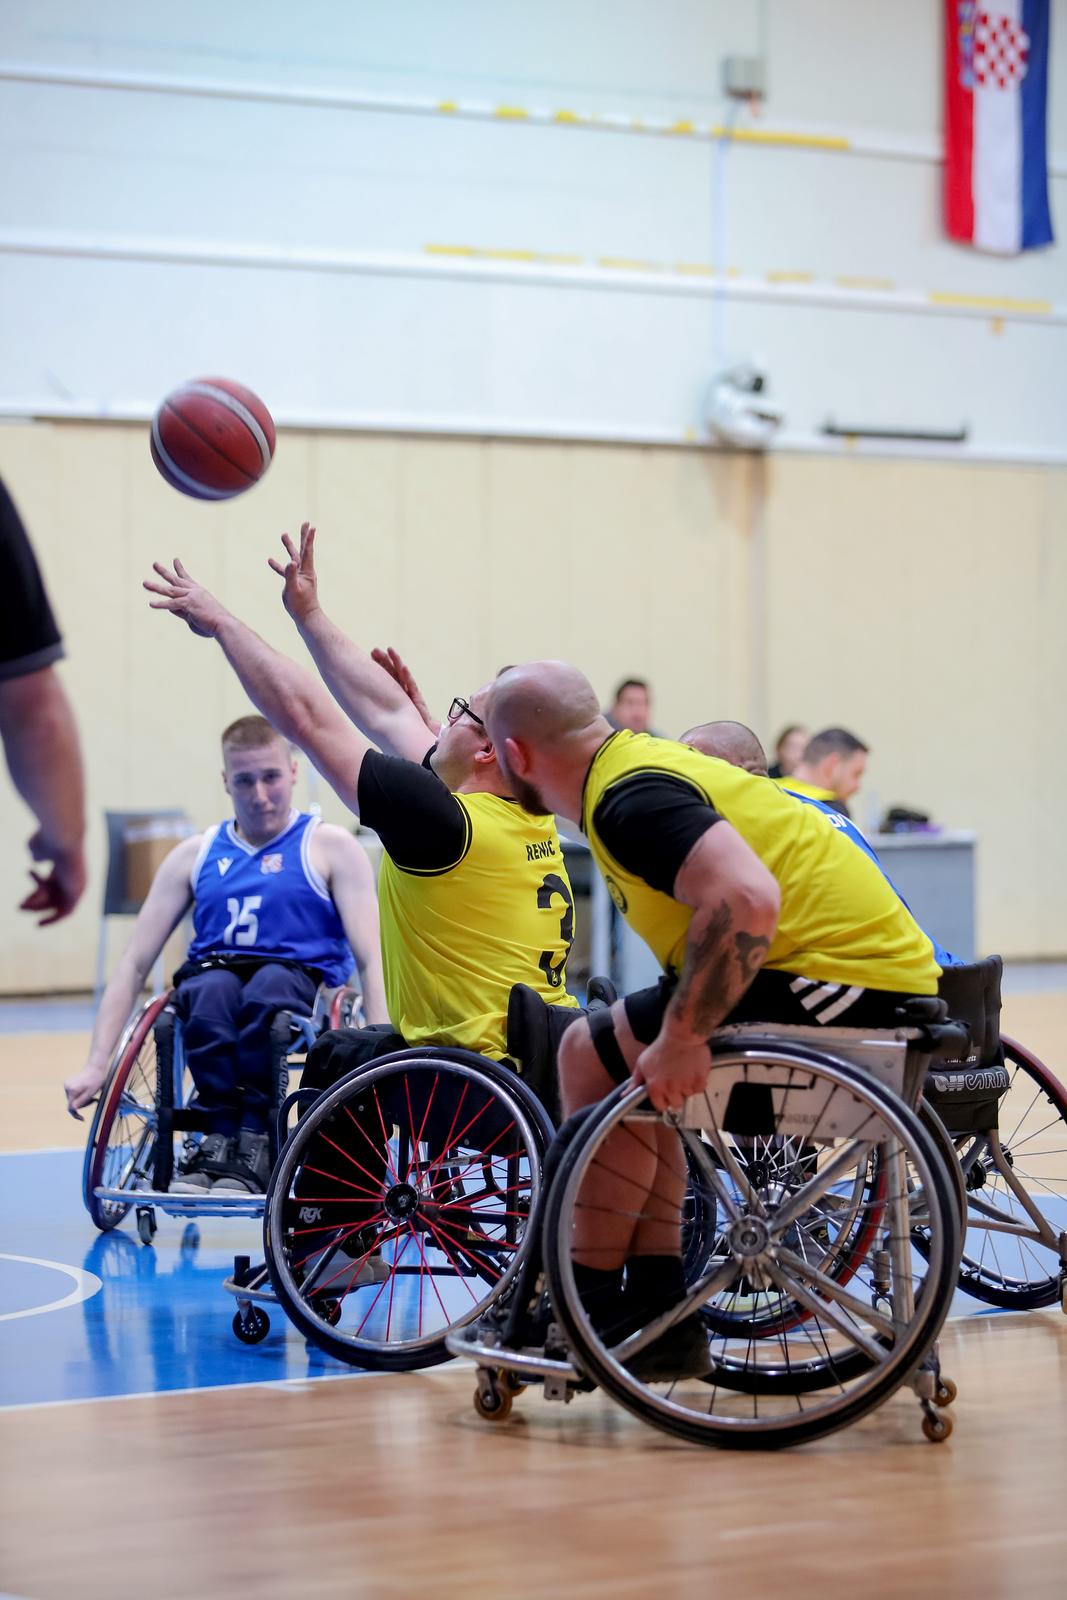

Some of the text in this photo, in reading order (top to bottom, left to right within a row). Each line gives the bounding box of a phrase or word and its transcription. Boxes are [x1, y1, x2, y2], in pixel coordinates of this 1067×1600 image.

[525, 835, 556, 861] RENIĆ
[223, 895, 263, 947] 15
[298, 1206, 323, 1224] RGK
